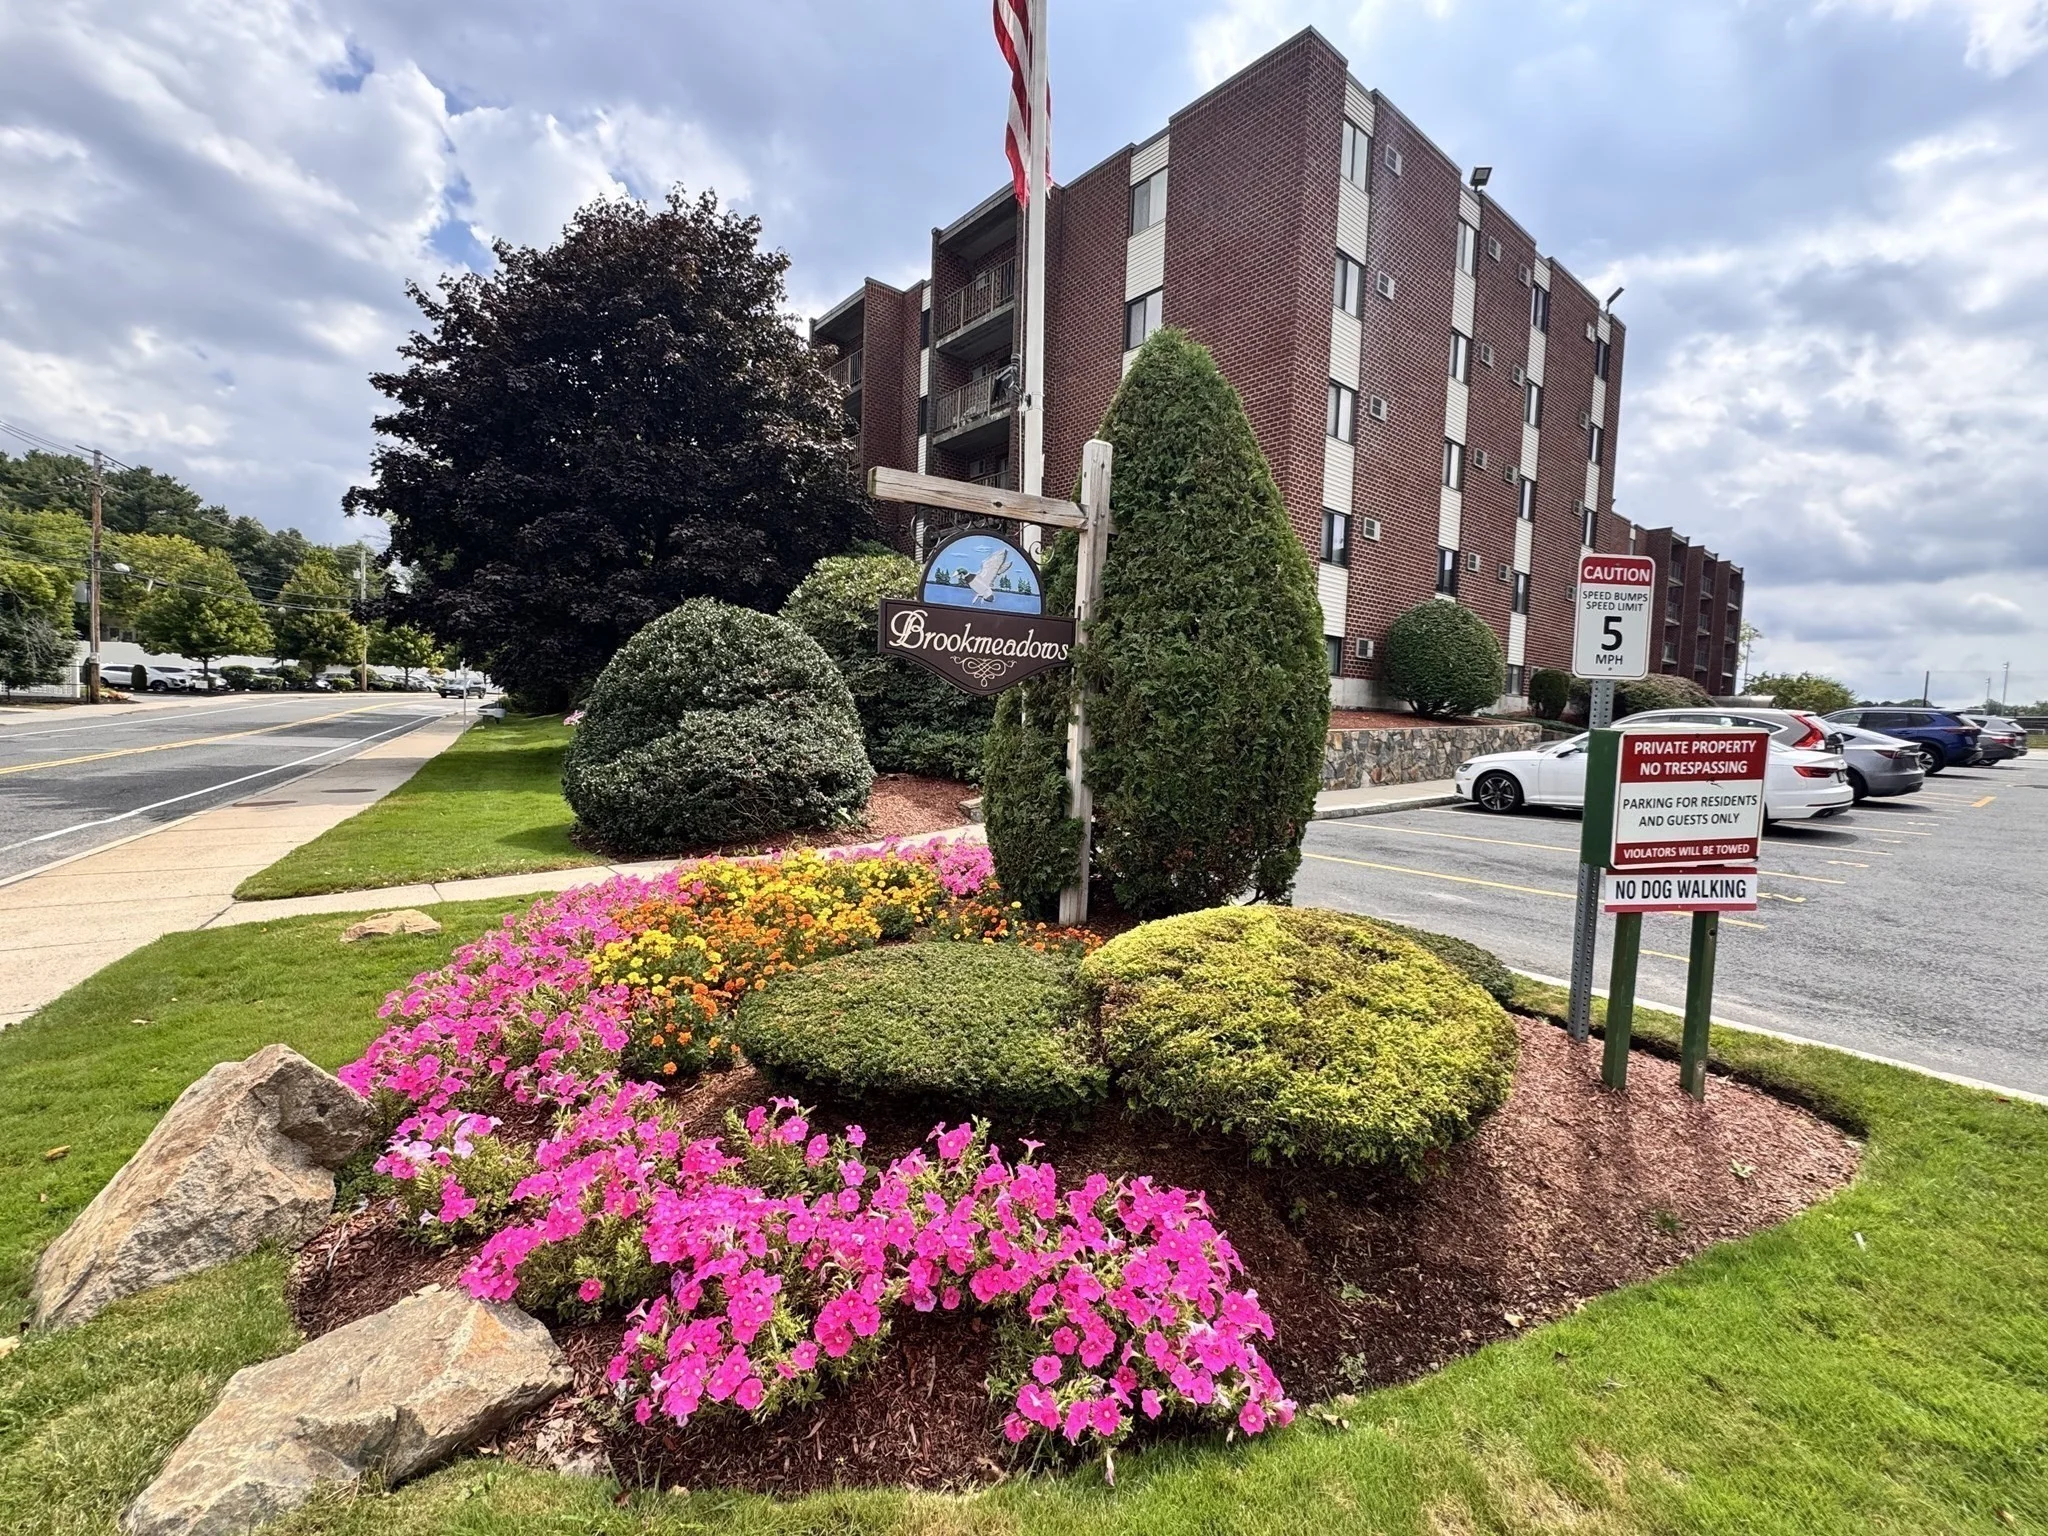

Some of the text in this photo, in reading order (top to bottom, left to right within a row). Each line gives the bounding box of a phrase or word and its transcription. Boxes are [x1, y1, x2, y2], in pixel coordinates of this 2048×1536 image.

[1583, 565, 1650, 582] CAUTION
[1582, 590, 1648, 602] SPEED BUMPS
[1586, 600, 1643, 612] SPEED LIMIT
[889, 609, 1069, 661] Brookmeadows
[1601, 615, 1623, 651] 5
[1595, 654, 1623, 665] MPH
[1634, 740, 1757, 755] PRIVATE PROPERTY
[1639, 760, 1748, 776] NO TRESPASSING
[1622, 794, 1758, 810] PARKING FOR RESIDENTS
[1638, 813, 1740, 827] AND GUESTS ONLY
[1623, 843, 1750, 859] VIOLATORS WILL BE TOWED
[1615, 880, 1636, 900] NO
[1641, 880, 1672, 899] DOG
[1677, 879, 1747, 899] WALKING
